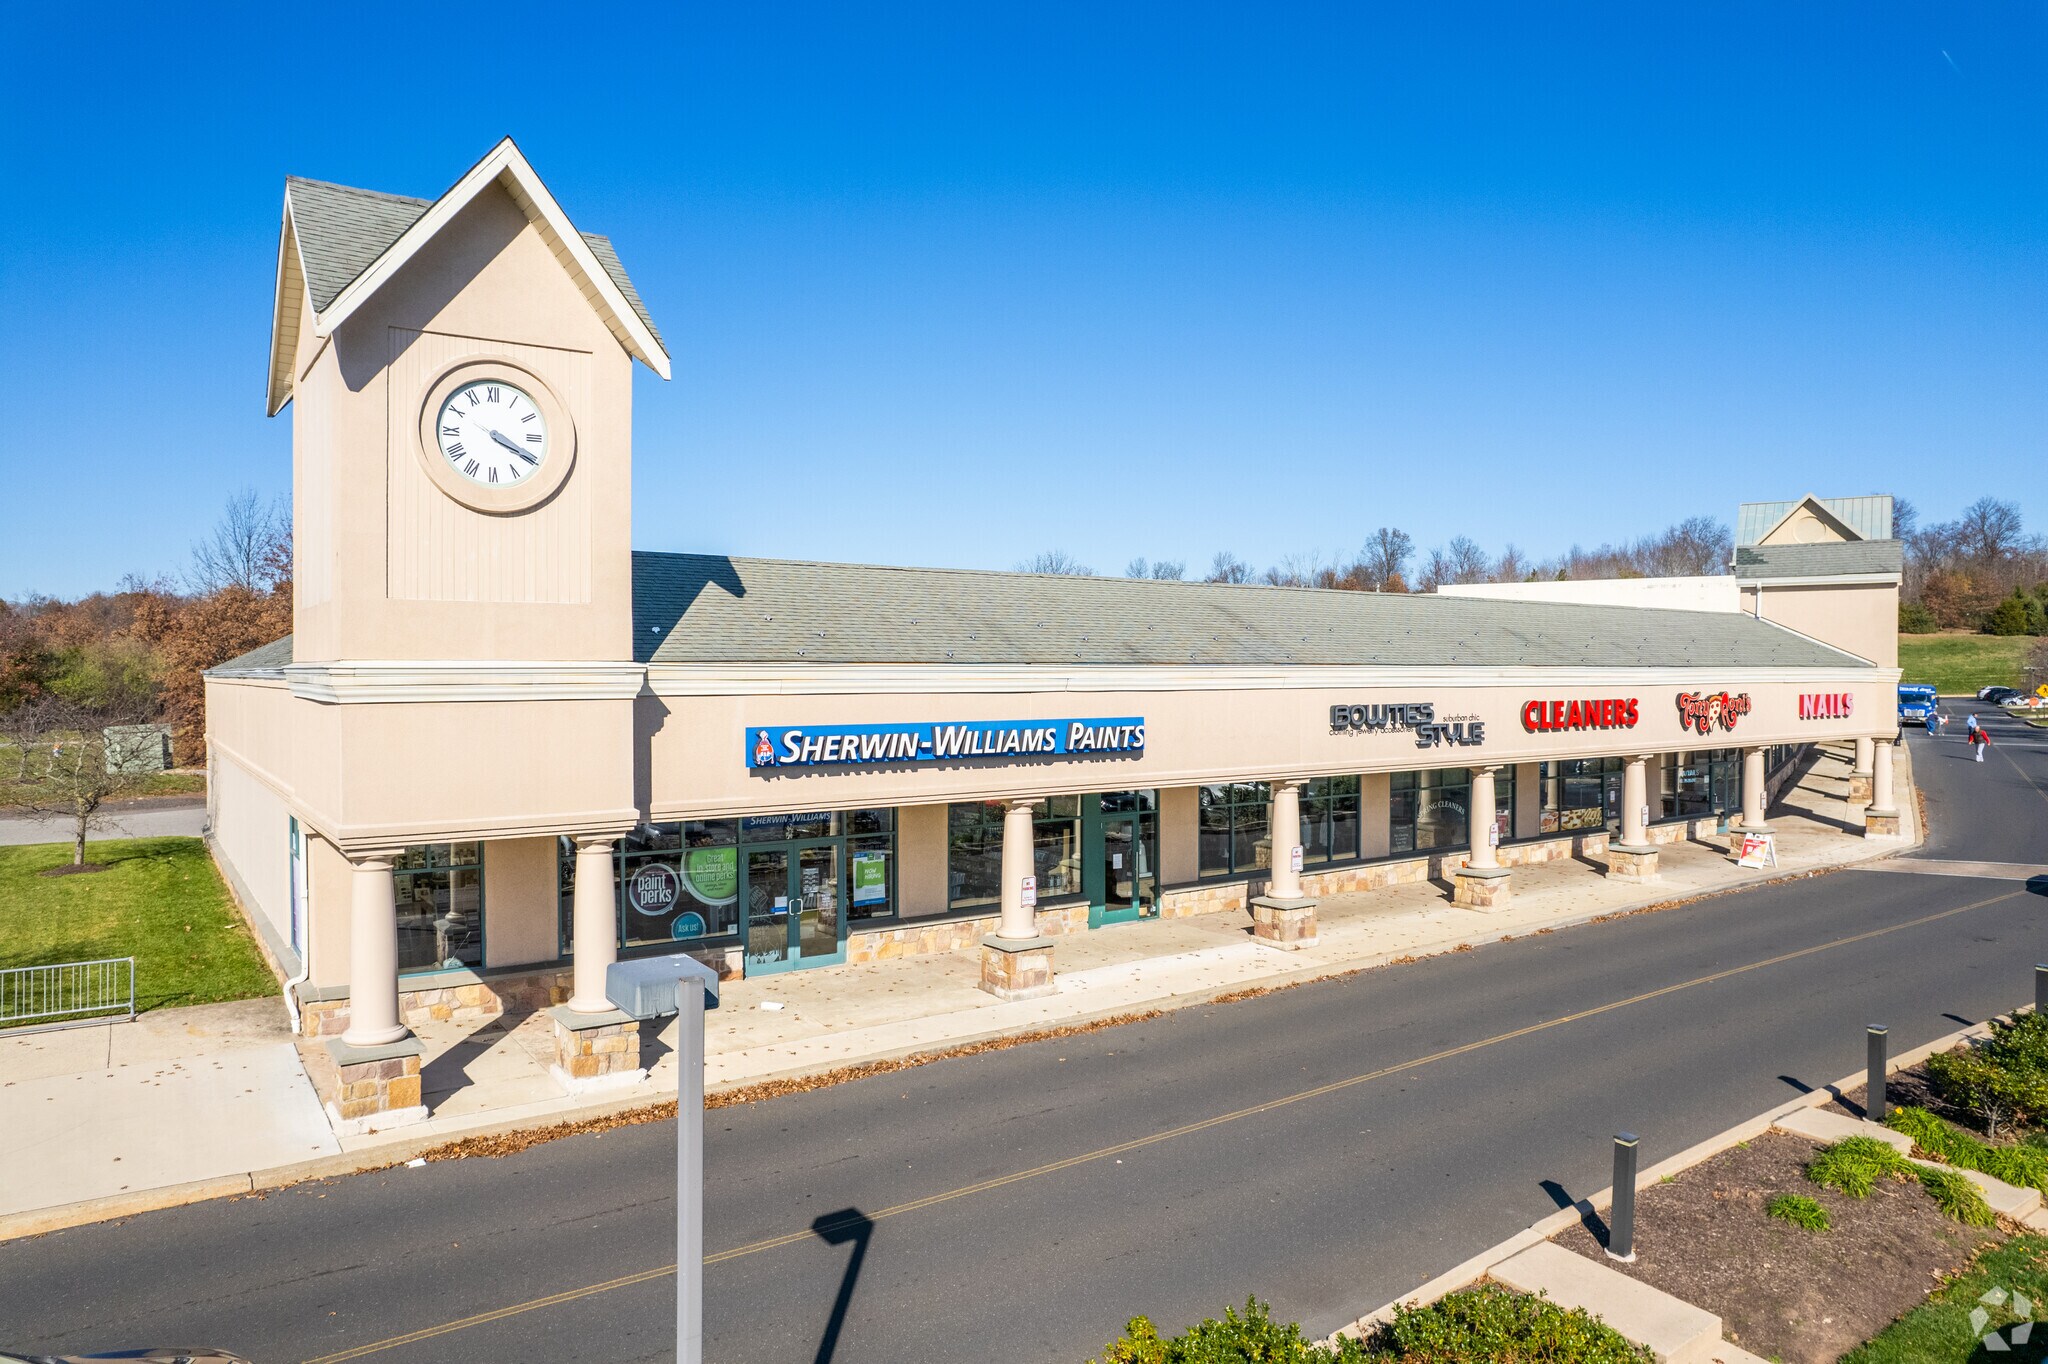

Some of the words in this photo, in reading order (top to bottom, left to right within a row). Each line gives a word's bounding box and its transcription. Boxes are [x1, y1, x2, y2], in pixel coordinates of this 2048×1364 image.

[464, 389, 480, 407] XI
[487, 386, 500, 403] XII
[509, 395, 519, 409] I
[448, 404, 466, 418] X
[520, 412, 537, 423] II
[442, 425, 460, 437] IX
[526, 433, 542, 443] III
[446, 442, 467, 462] VIII
[463, 458, 480, 478] VII
[488, 466, 499, 483] VI
[509, 463, 521, 480] V
[1677, 691, 1709, 732] Tony
[1799, 693, 1854, 718] NAILS
[1330, 703, 1435, 729] BOWTIES
[1442, 713, 1468, 723] suburban
[1522, 698, 1639, 731] CLEANERS
[779, 725, 1057, 764] SHERWIN-WILLIAMS
[1067, 722, 1145, 750] PAINTS
[1415, 722, 1485, 747] STYLE
[1437, 800, 1466, 816] CLEANERS
[750, 812, 831, 826] SHERWIN-WILLIAMS
[722, 861, 734, 871] and
[637, 874, 666, 893] paint
[695, 872, 715, 883] online
[640, 888, 672, 907] perks
[677, 924, 690, 933] Ask
[690, 922, 699, 932] us!
